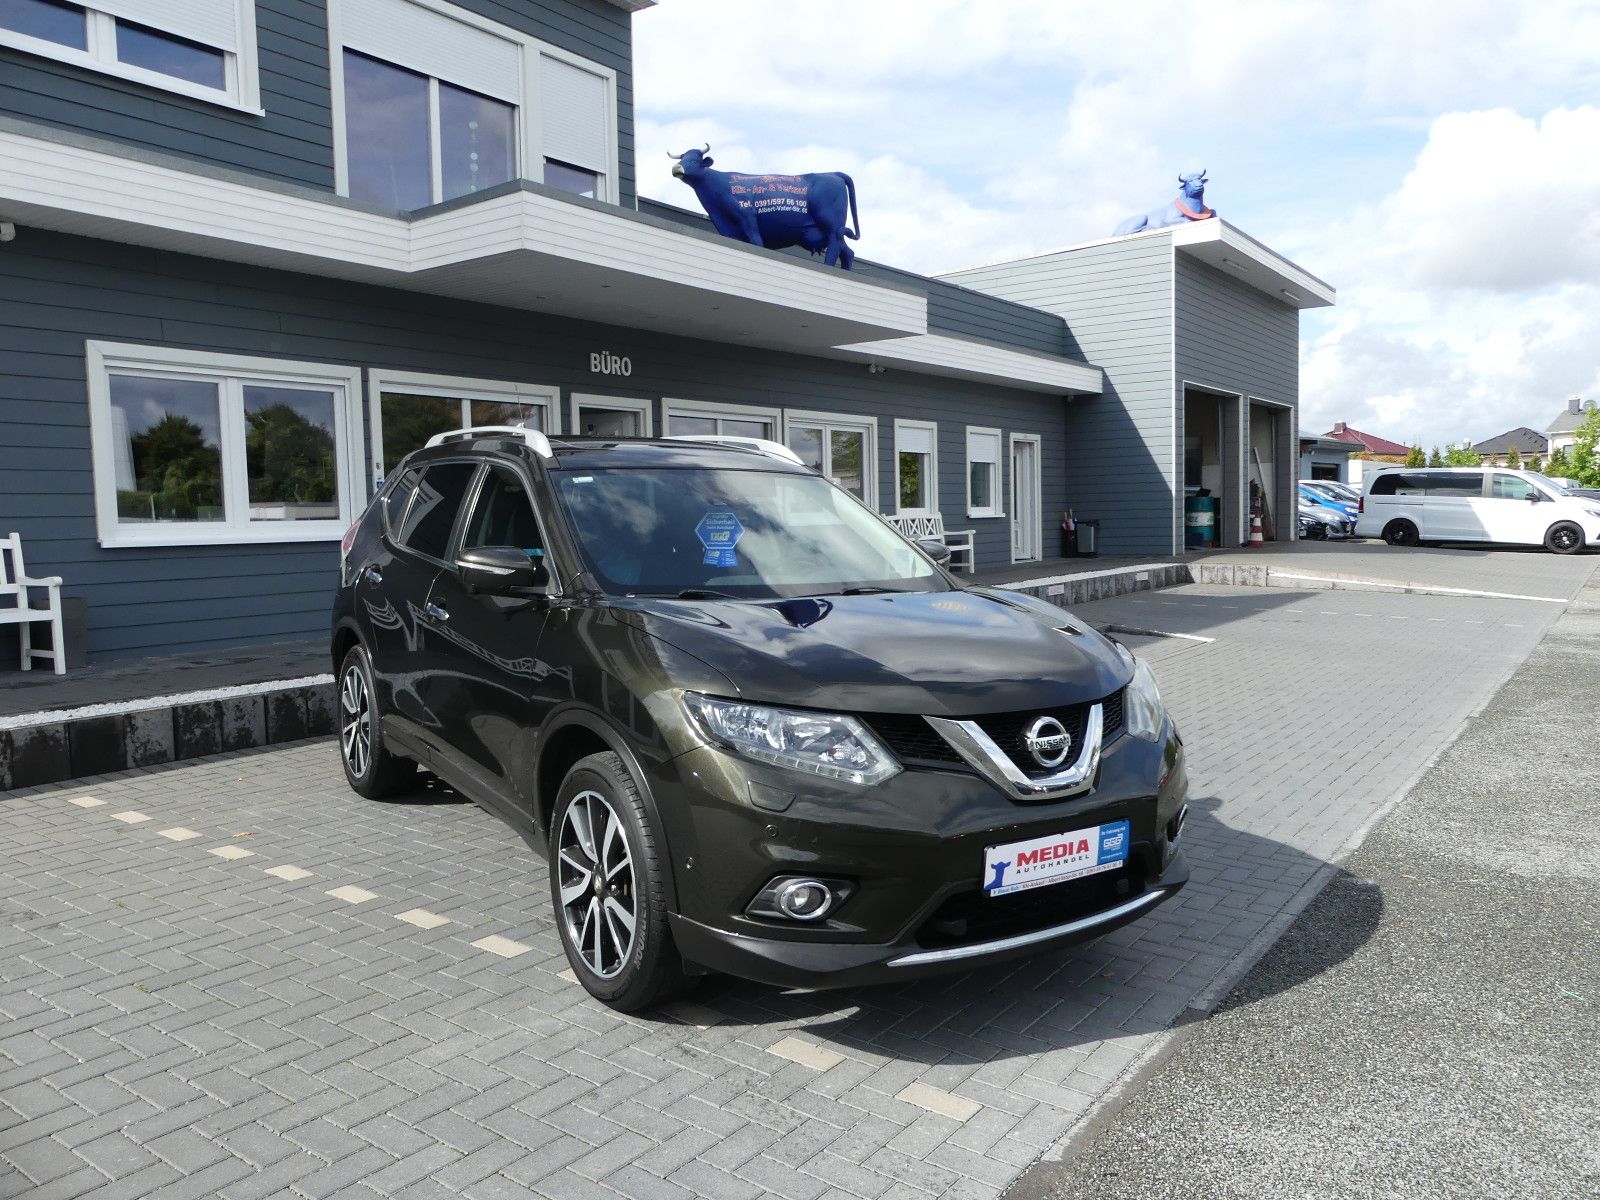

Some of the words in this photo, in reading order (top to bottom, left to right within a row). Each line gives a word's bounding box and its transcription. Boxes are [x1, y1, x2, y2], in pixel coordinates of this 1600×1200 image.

[739, 200, 753, 208] Tel.
[754, 198, 785, 208] 0391/597
[796, 200, 807, 208] 100
[590, 350, 632, 377] BÜRO
[1035, 735, 1070, 749] NISSAN
[1017, 839, 1090, 868] MEDIA
[1016, 855, 1091, 875] AUTOHANDEL
